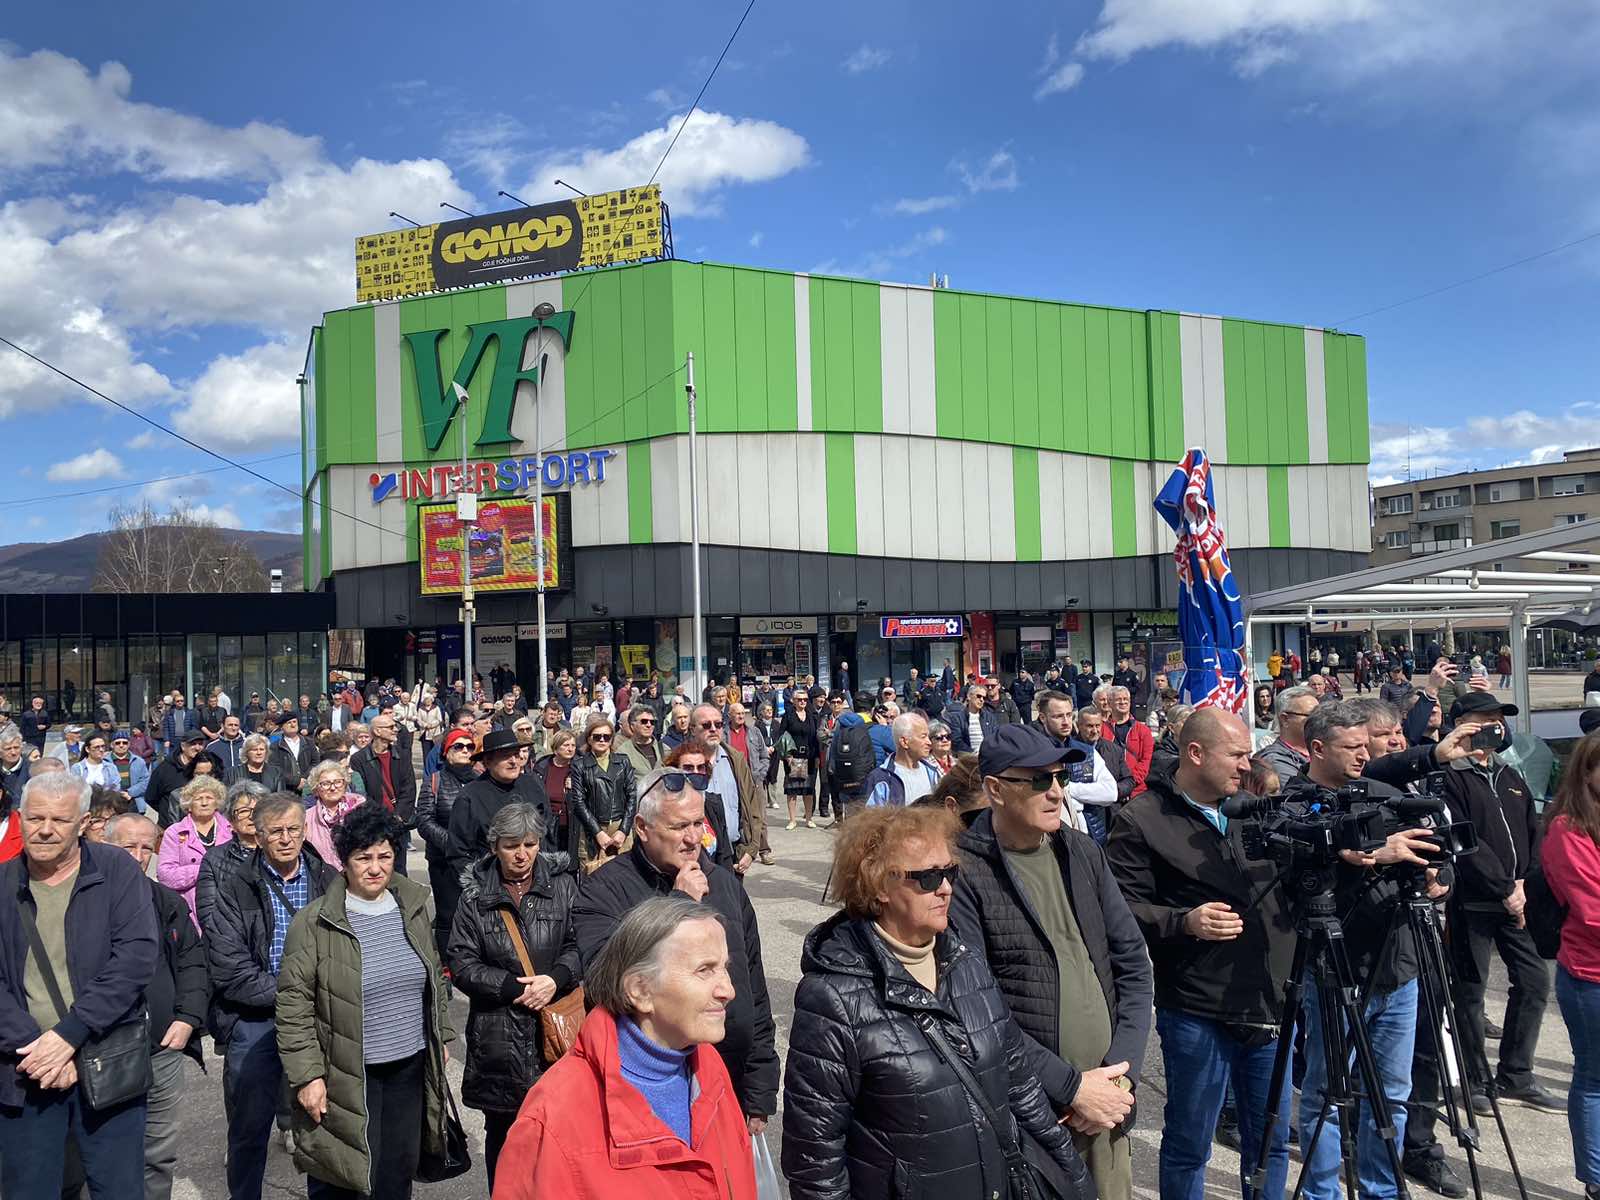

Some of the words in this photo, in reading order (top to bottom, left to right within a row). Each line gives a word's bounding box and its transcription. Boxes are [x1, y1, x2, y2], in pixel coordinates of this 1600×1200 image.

[402, 310, 575, 450] VF
[770, 621, 803, 630] IQOS
[886, 619, 947, 636] PREMIER
